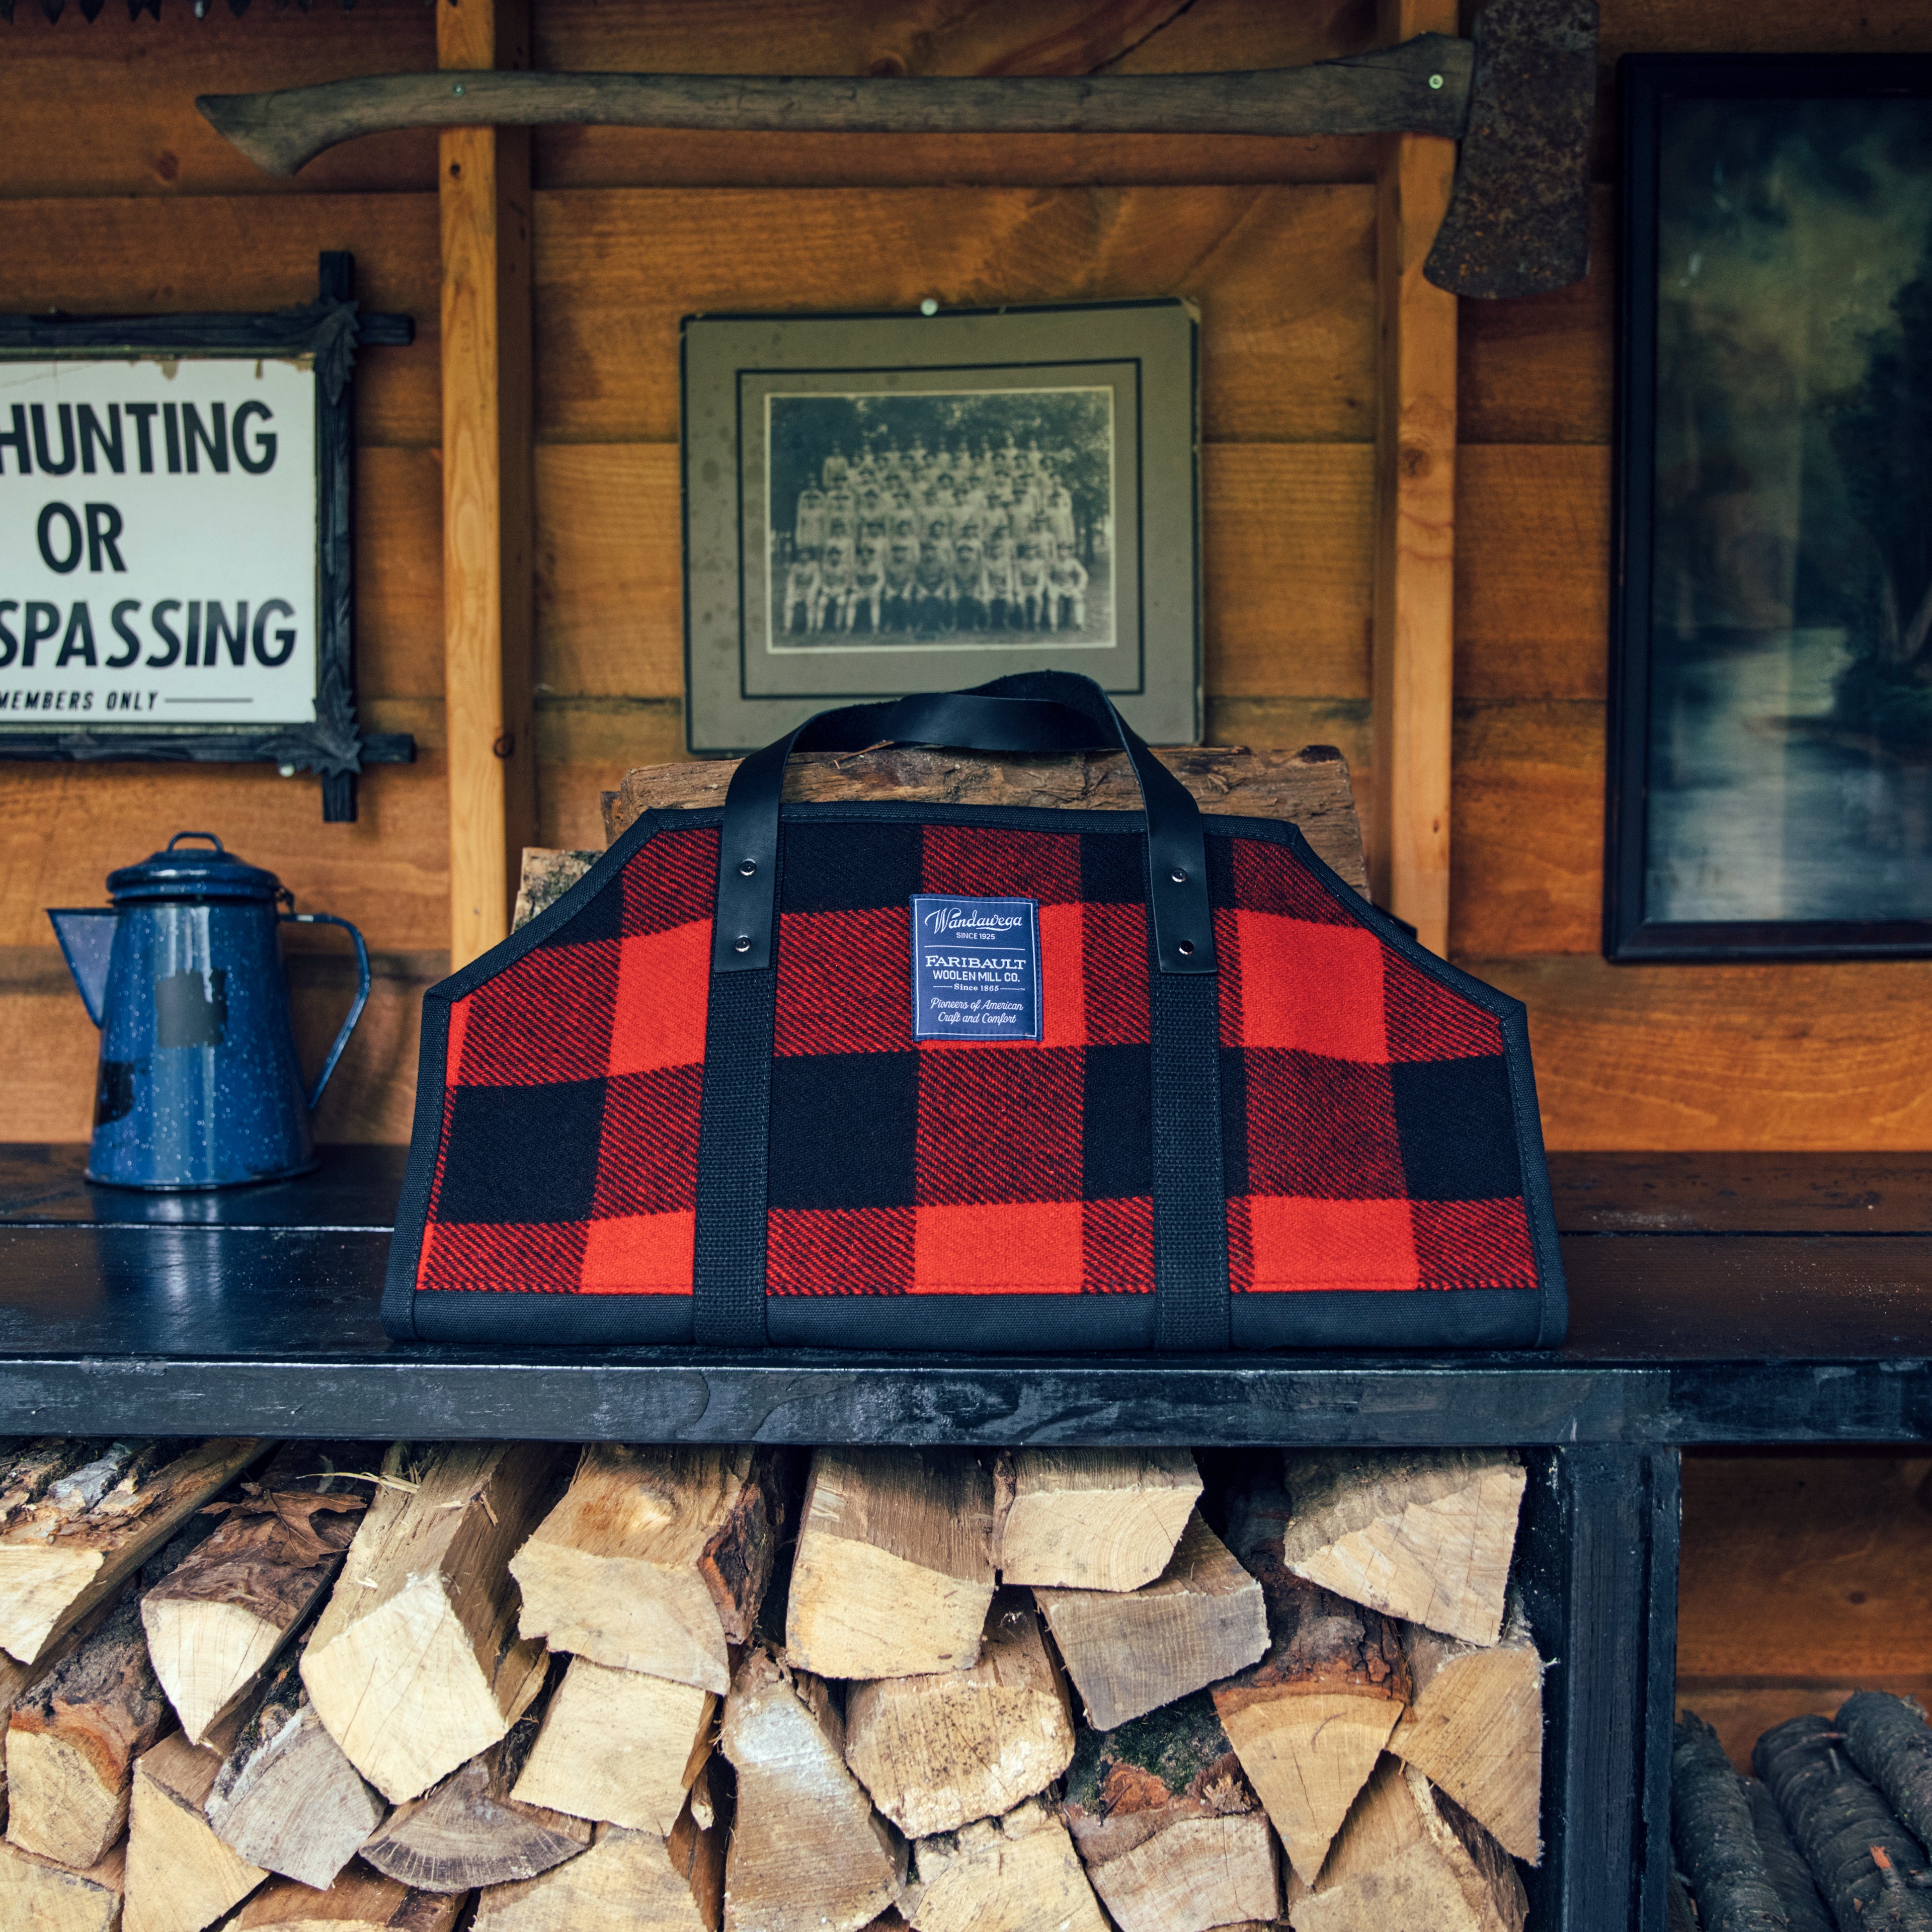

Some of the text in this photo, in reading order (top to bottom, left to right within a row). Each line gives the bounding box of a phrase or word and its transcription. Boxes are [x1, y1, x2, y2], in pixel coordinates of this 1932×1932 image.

[0, 401, 278, 475] HUNTING
[37, 502, 128, 574] OR
[106, 691, 158, 710] ONLY
[924, 907, 1022, 934] Wandawega
[925, 955, 1026, 969] FARIBAULT
[933, 970, 1020, 982] WOOLEN MILL CO.
[931, 997, 1023, 1012] Pioneers of American
[938, 1012, 1016, 1026] Craft and Comfort
